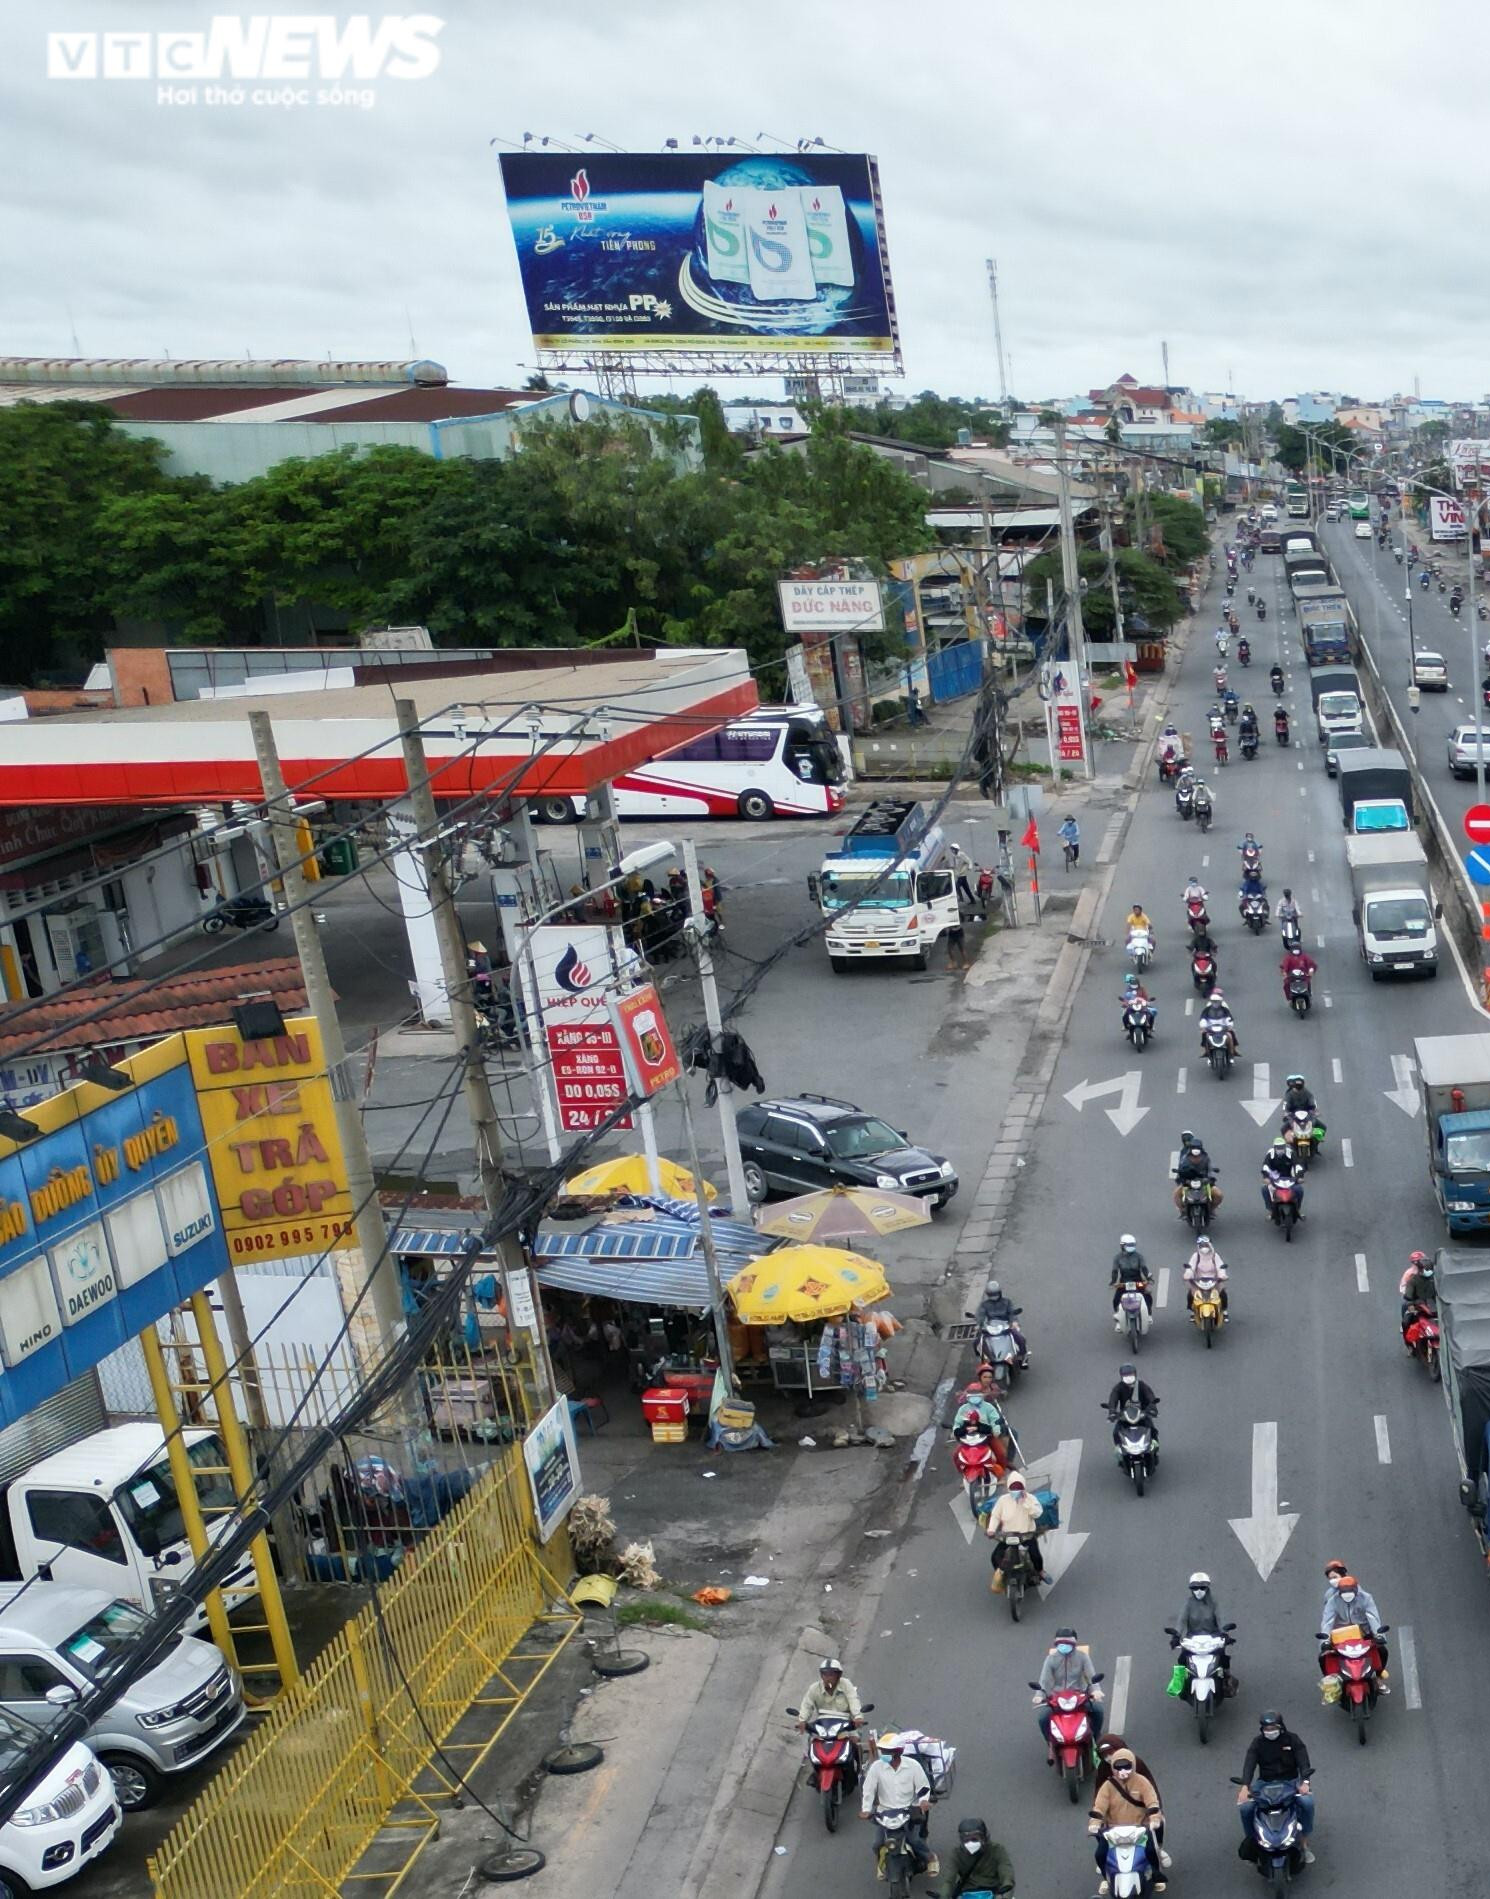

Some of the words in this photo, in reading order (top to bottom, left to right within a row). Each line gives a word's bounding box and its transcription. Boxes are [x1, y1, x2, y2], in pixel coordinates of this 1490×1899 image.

[629, 294, 657, 311] PP
[564, 1084, 582, 1098] DO
[585, 1083, 620, 1099] 0,05S
[649, 1066, 676, 1089] PETRO
[230, 1081, 303, 1121] XE
[568, 1110, 590, 1126] 24
[229, 1122, 330, 1174] TRẢ
[29, 1165, 93, 1224] DƯỠNG
[92, 1143, 120, 1186] ỦY
[123, 1110, 179, 1173] QUYỀN
[240, 1176, 338, 1222] GÓP
[173, 1212, 213, 1248] SUZUKI
[233, 1233, 275, 1254] 0902
[280, 1226, 314, 1247] 995
[68, 1274, 113, 1317] DAEWOO
[19, 1323, 52, 1352] HINO
